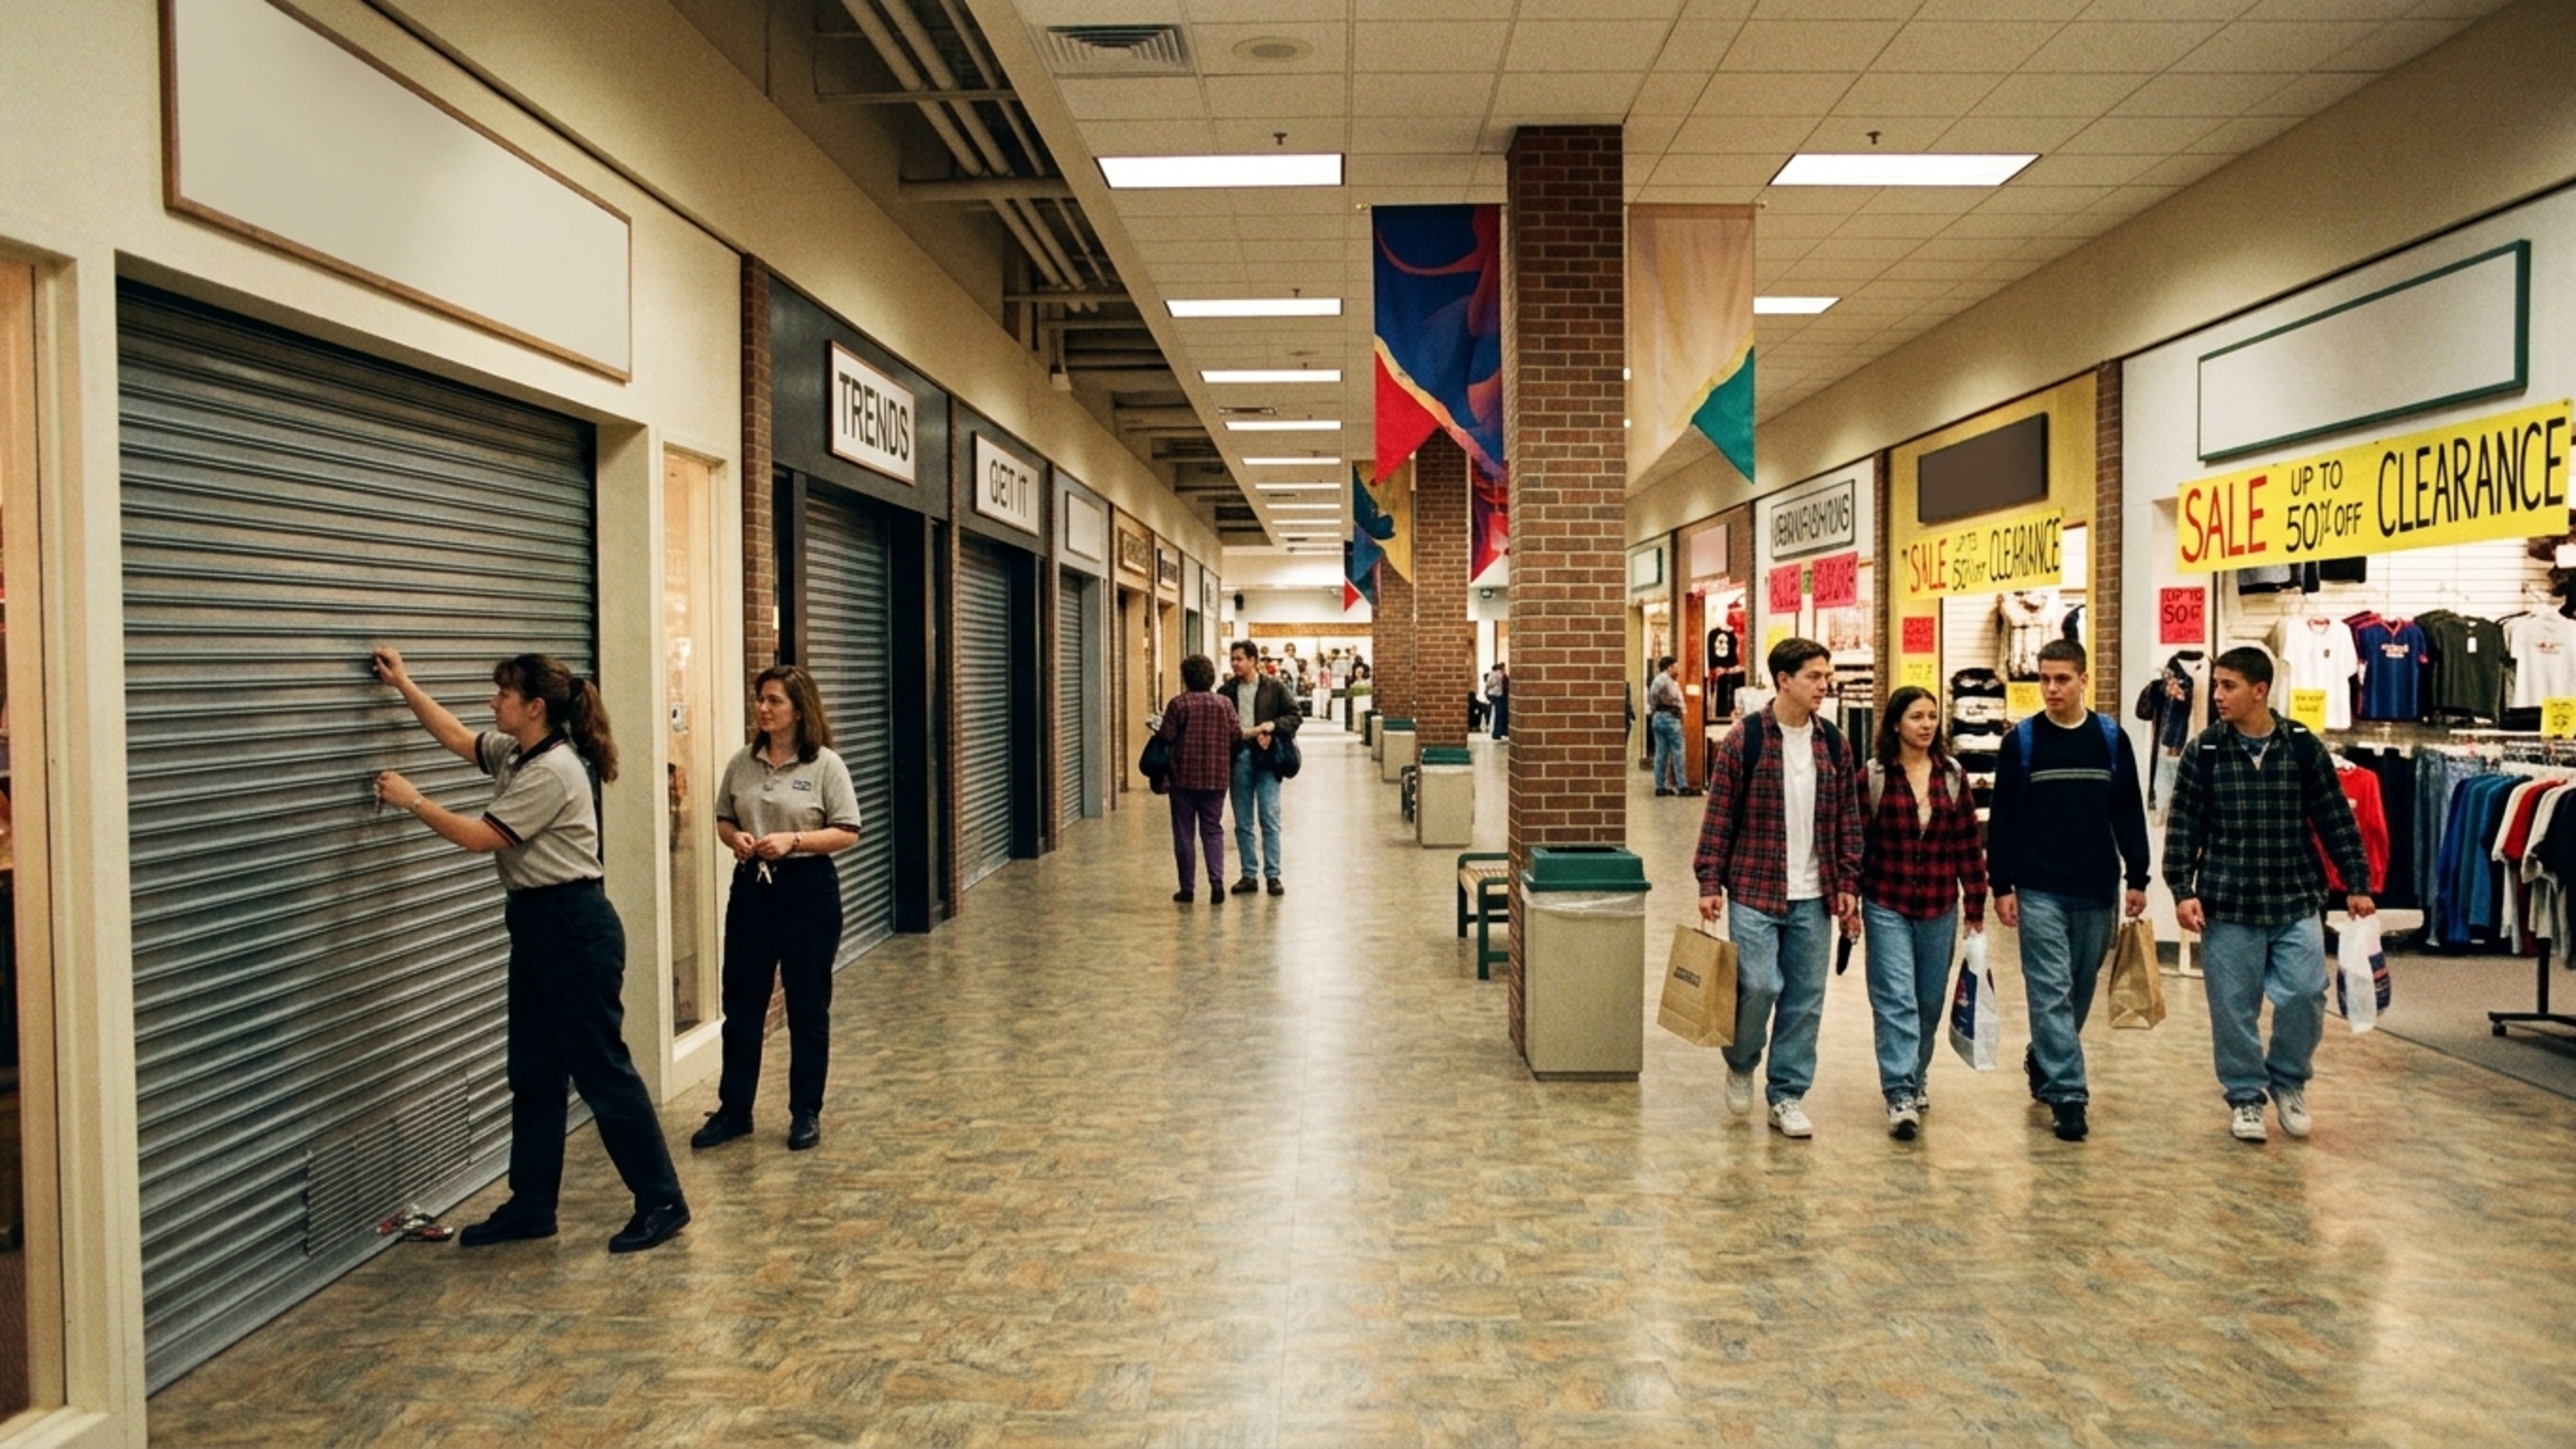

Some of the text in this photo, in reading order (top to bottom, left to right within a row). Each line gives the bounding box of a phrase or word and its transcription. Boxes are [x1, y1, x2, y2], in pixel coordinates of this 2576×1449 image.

[838, 370, 910, 462] TRENDS
[989, 458, 1029, 518] GET IT
[2291, 459, 2343, 496] UP TO
[2377, 416, 2567, 538] CLEARANCE
[1989, 517, 2061, 582] CLEARANCE
[2181, 474, 2268, 564] SALE
[2334, 501, 2364, 538] OFF
[1910, 538, 1948, 594] SALE
